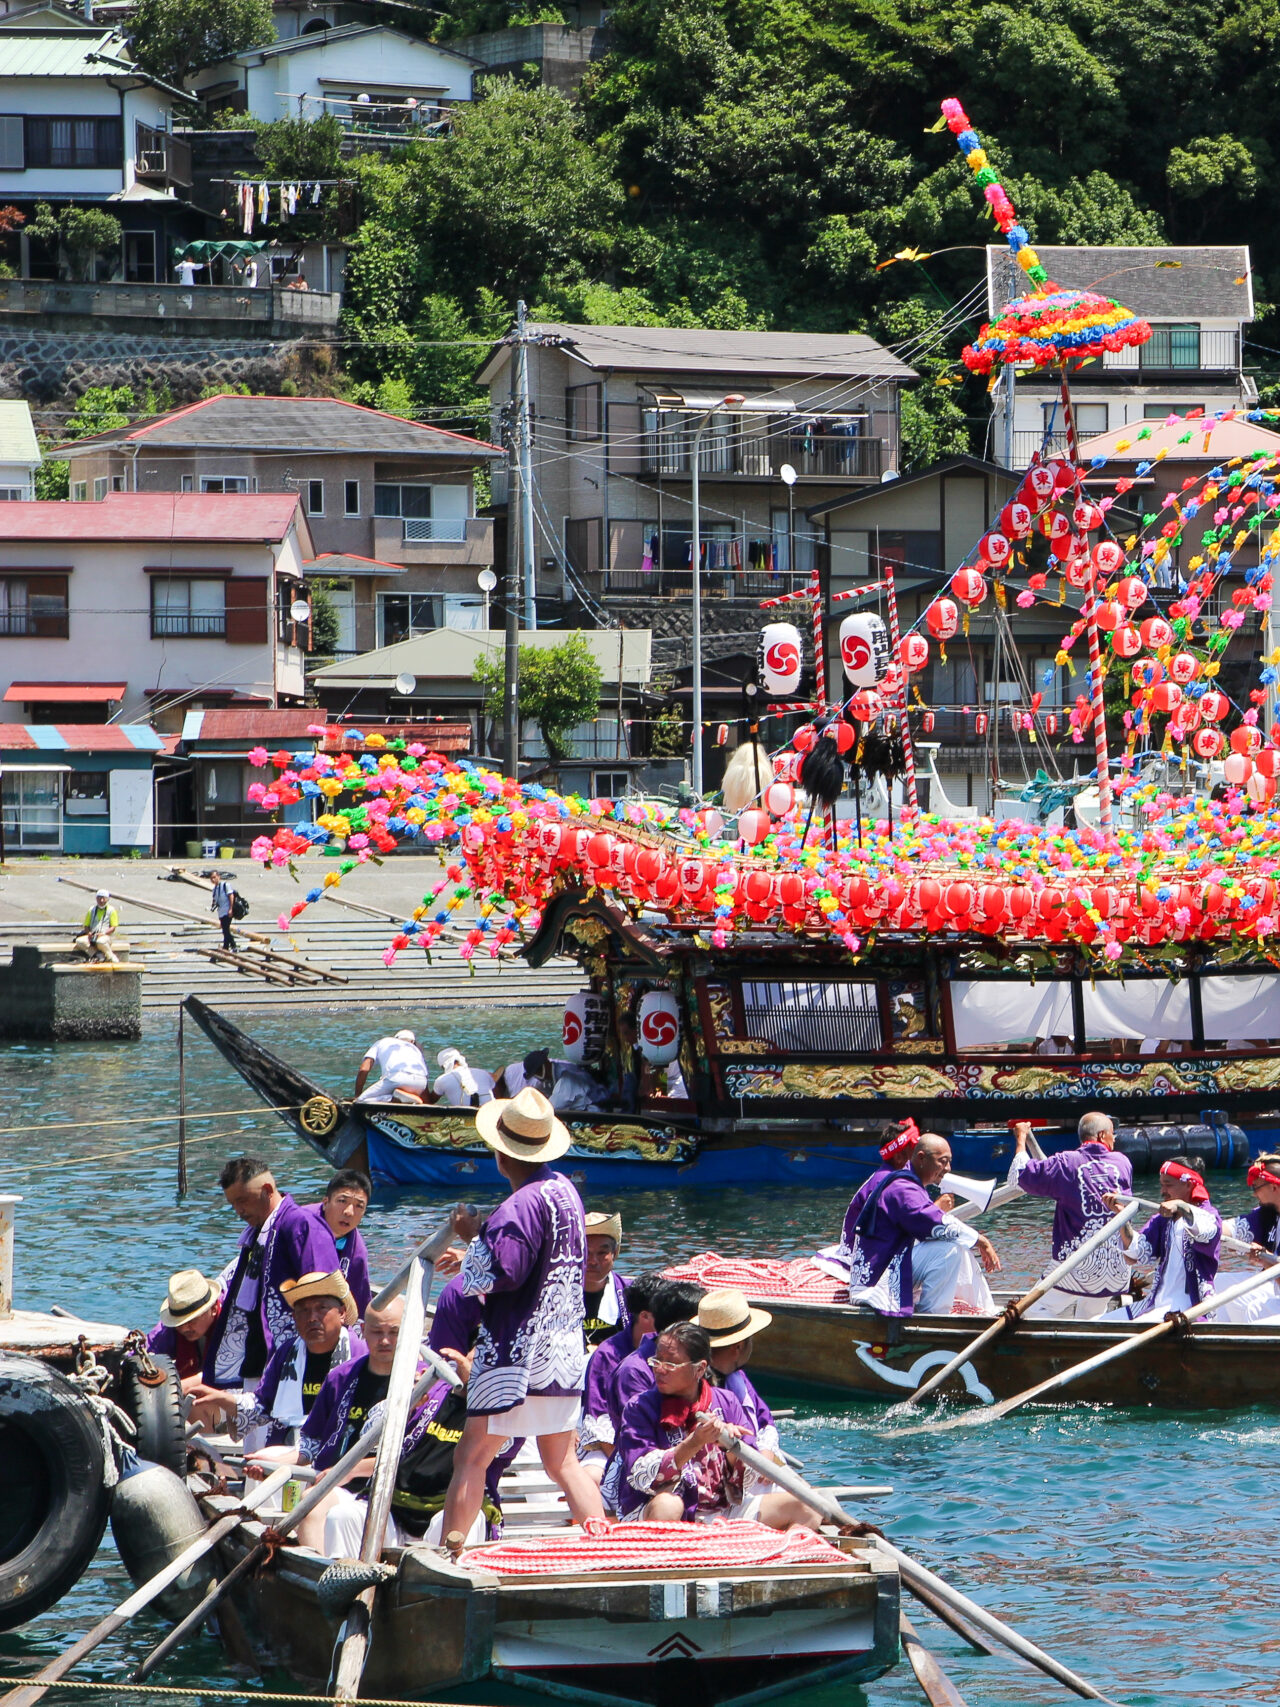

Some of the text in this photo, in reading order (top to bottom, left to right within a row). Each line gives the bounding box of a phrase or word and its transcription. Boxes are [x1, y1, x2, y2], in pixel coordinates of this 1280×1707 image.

[1035, 470, 1052, 486] 東
[1016, 509, 1030, 524] 東
[1075, 508, 1089, 523] 東
[1055, 519, 1069, 533] 東
[992, 539, 1009, 555] 東
[1100, 547, 1116, 562] 東
[972, 575, 982, 590] 東
[1131, 584, 1145, 600] 東
[945, 606, 957, 620] 東
[1152, 625, 1167, 640] 東
[912, 642, 924, 658] 東
[1176, 659, 1191, 674] 東
[1201, 697, 1215, 714] 東
[1200, 735, 1215, 750] 東
[543, 829, 557, 847] 東
[611, 850, 621, 867] 東
[684, 866, 698, 885] 東
